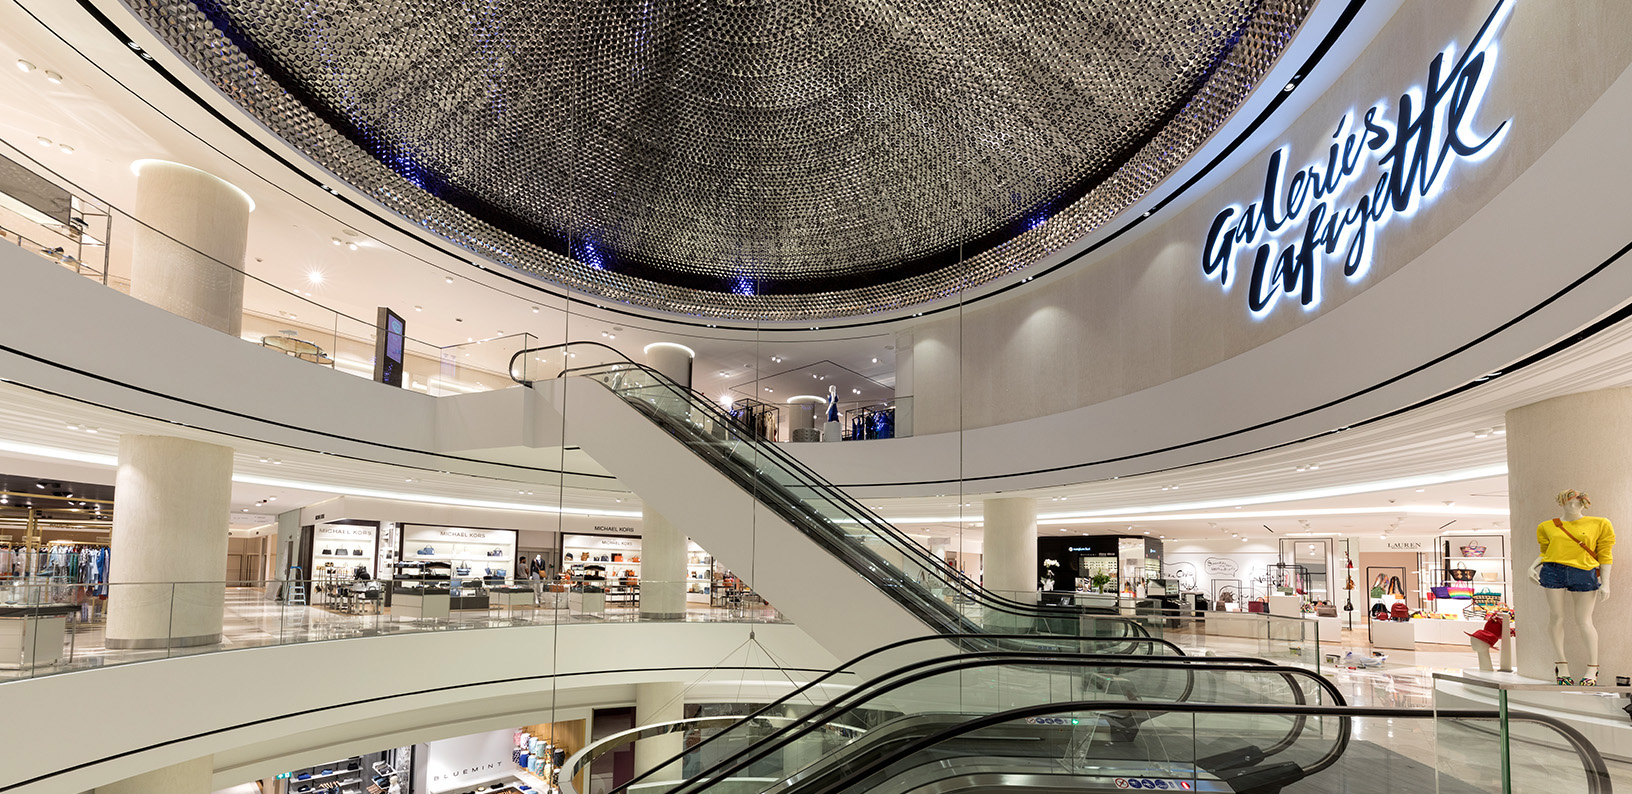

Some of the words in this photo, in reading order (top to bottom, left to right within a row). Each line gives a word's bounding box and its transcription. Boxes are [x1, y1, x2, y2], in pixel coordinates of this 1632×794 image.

[1202, 106, 1390, 286] Galeries
[1249, 0, 1508, 313] Lafayette
[433, 761, 502, 782] BLUEMINT
